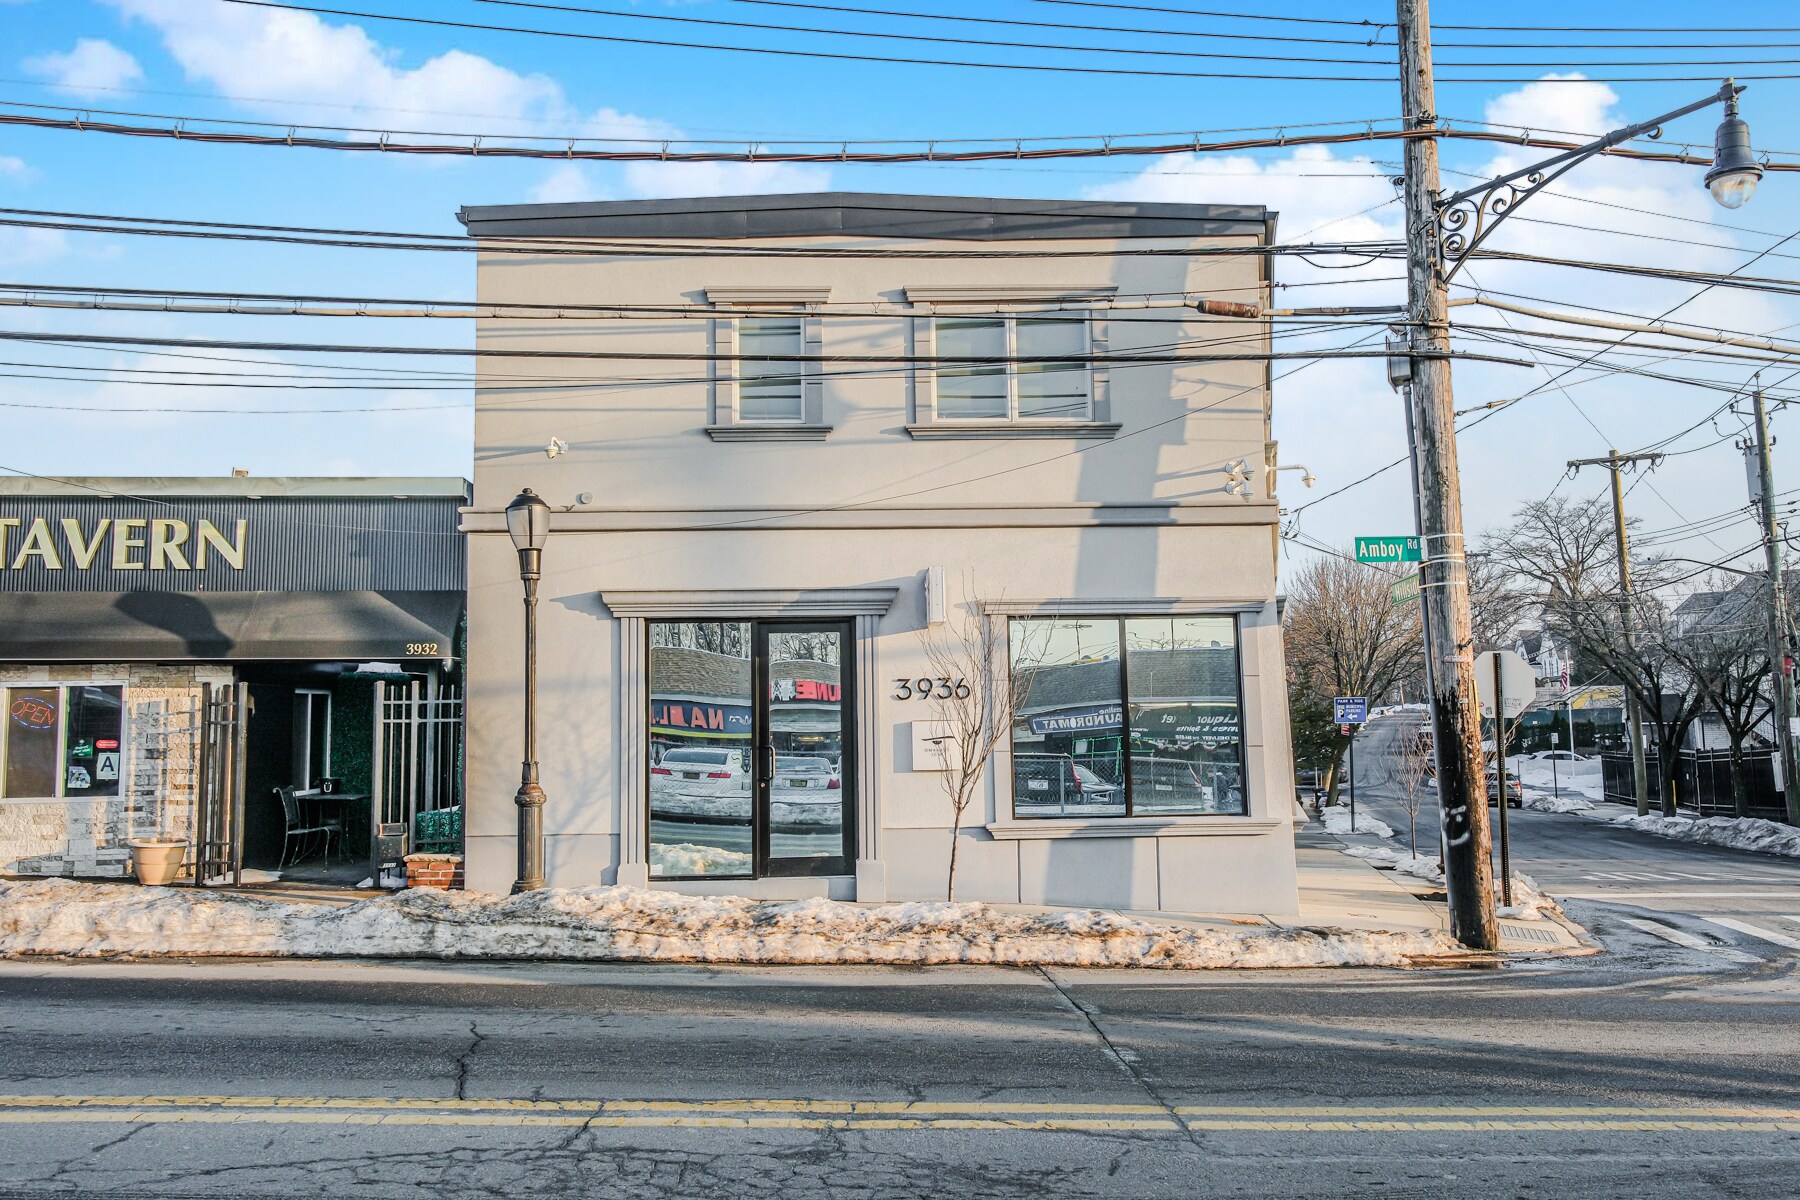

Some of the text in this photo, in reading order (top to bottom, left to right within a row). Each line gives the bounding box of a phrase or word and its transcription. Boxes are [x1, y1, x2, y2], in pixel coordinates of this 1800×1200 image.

[1360, 538, 1418, 560] Amboy Rd
[405, 643, 438, 655] 3932
[896, 677, 971, 700] 3936
[11, 700, 57, 725] OPEN
[1337, 709, 1344, 718] P
[100, 756, 115, 772] A
